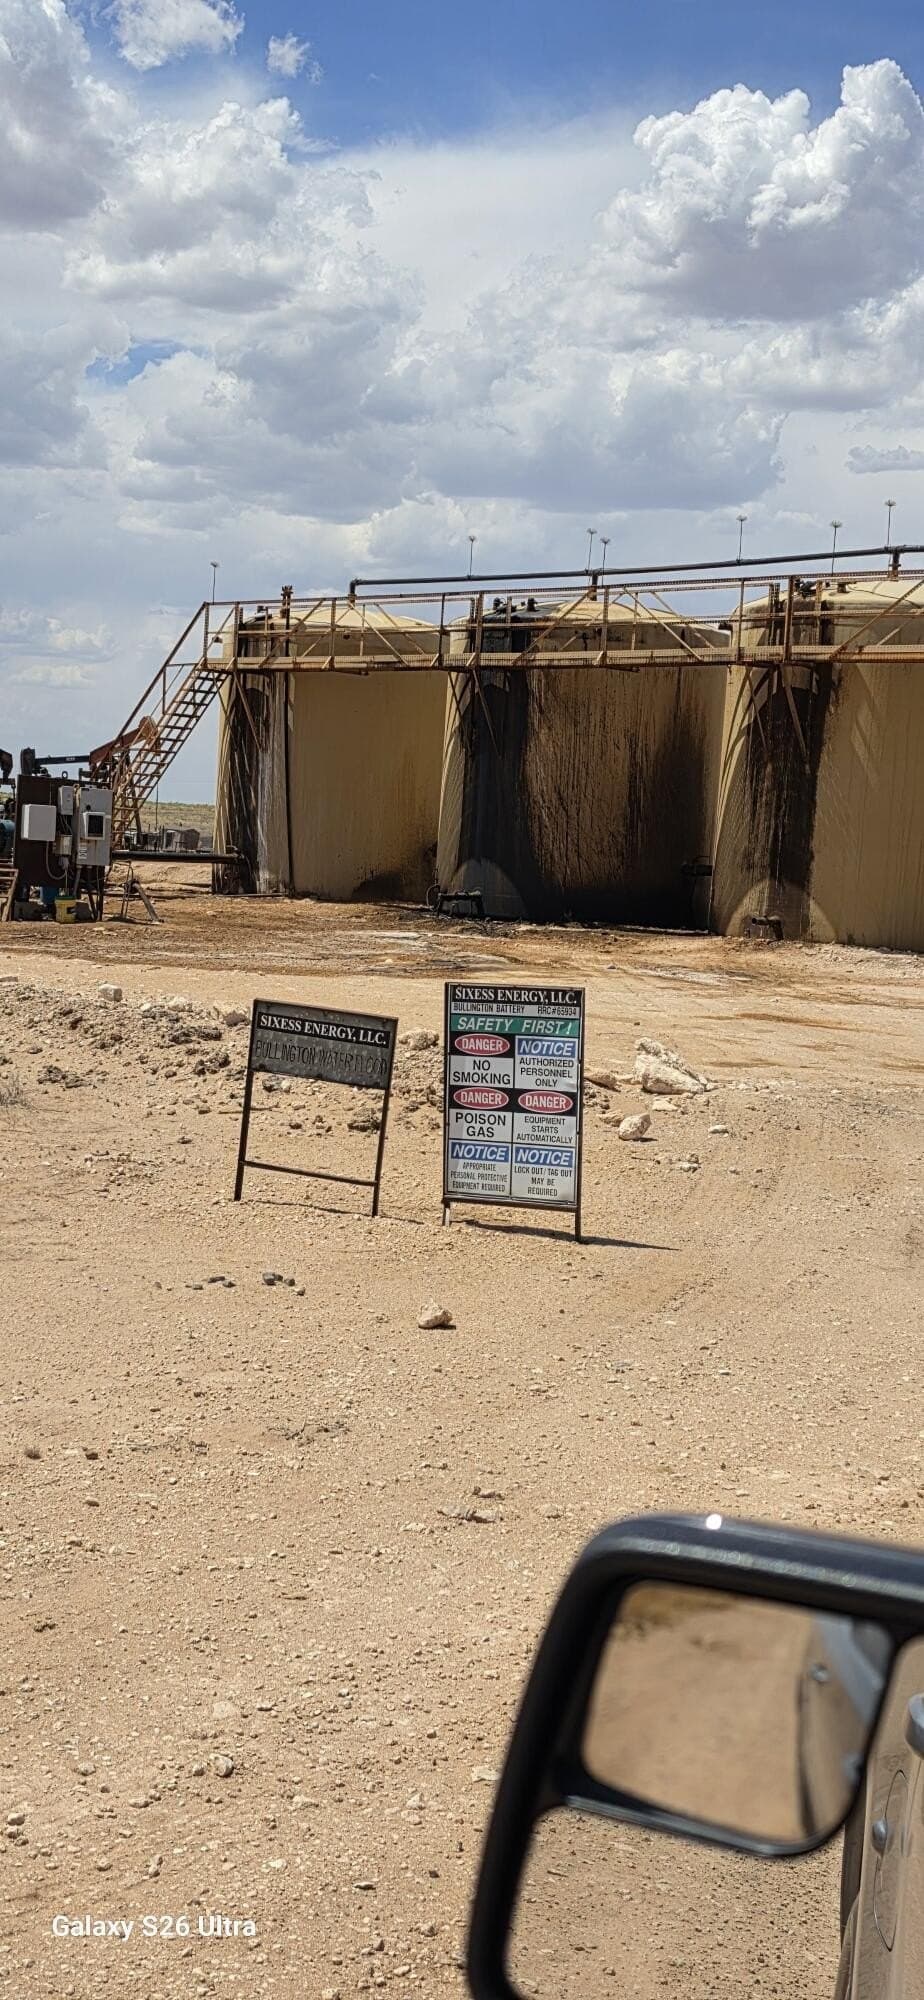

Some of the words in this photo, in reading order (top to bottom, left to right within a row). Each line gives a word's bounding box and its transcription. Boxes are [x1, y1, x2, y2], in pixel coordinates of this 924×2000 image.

[456, 987, 494, 1000] SIXESS
[498, 990, 548, 1004] ENERGY,
[551, 991, 577, 1004] LLC.
[454, 1002, 493, 1013] BULLINGTON
[496, 1004, 525, 1014] BATTERY
[260, 1014, 302, 1032] SIXESS
[304, 1021, 356, 1041] ENERGY,
[360, 1030, 386, 1045] LLC.
[457, 1016, 514, 1032] SAFETY
[462, 1038, 502, 1051] DANGER
[520, 1040, 574, 1056] NOTICE
[472, 1060, 491, 1072] NO
[520, 1058, 574, 1068] AUTHORIZED
[452, 1072, 511, 1085] SMOKING
[520, 1068, 573, 1078] PERSONNEL
[535, 1078, 558, 1087] ONLY
[460, 1092, 502, 1104] DANGER
[526, 1095, 567, 1109] DANGER
[455, 1112, 506, 1126] POISON
[524, 1116, 566, 1126] EQUIPMENT
[466, 1126, 495, 1138] GAS
[532, 1125, 558, 1134] STARTS
[516, 1133, 573, 1144] AUTOMATICALLY
[453, 1144, 508, 1160] NOTICE
[517, 1149, 571, 1166] NOTICE
[514, 1166, 530, 1174] LOCK
[560, 1169, 572, 1178] OUT
[531, 1177, 544, 1185] MAY
[546, 1178, 556, 1186] BE
[528, 1186, 558, 1197] REQUIRED
